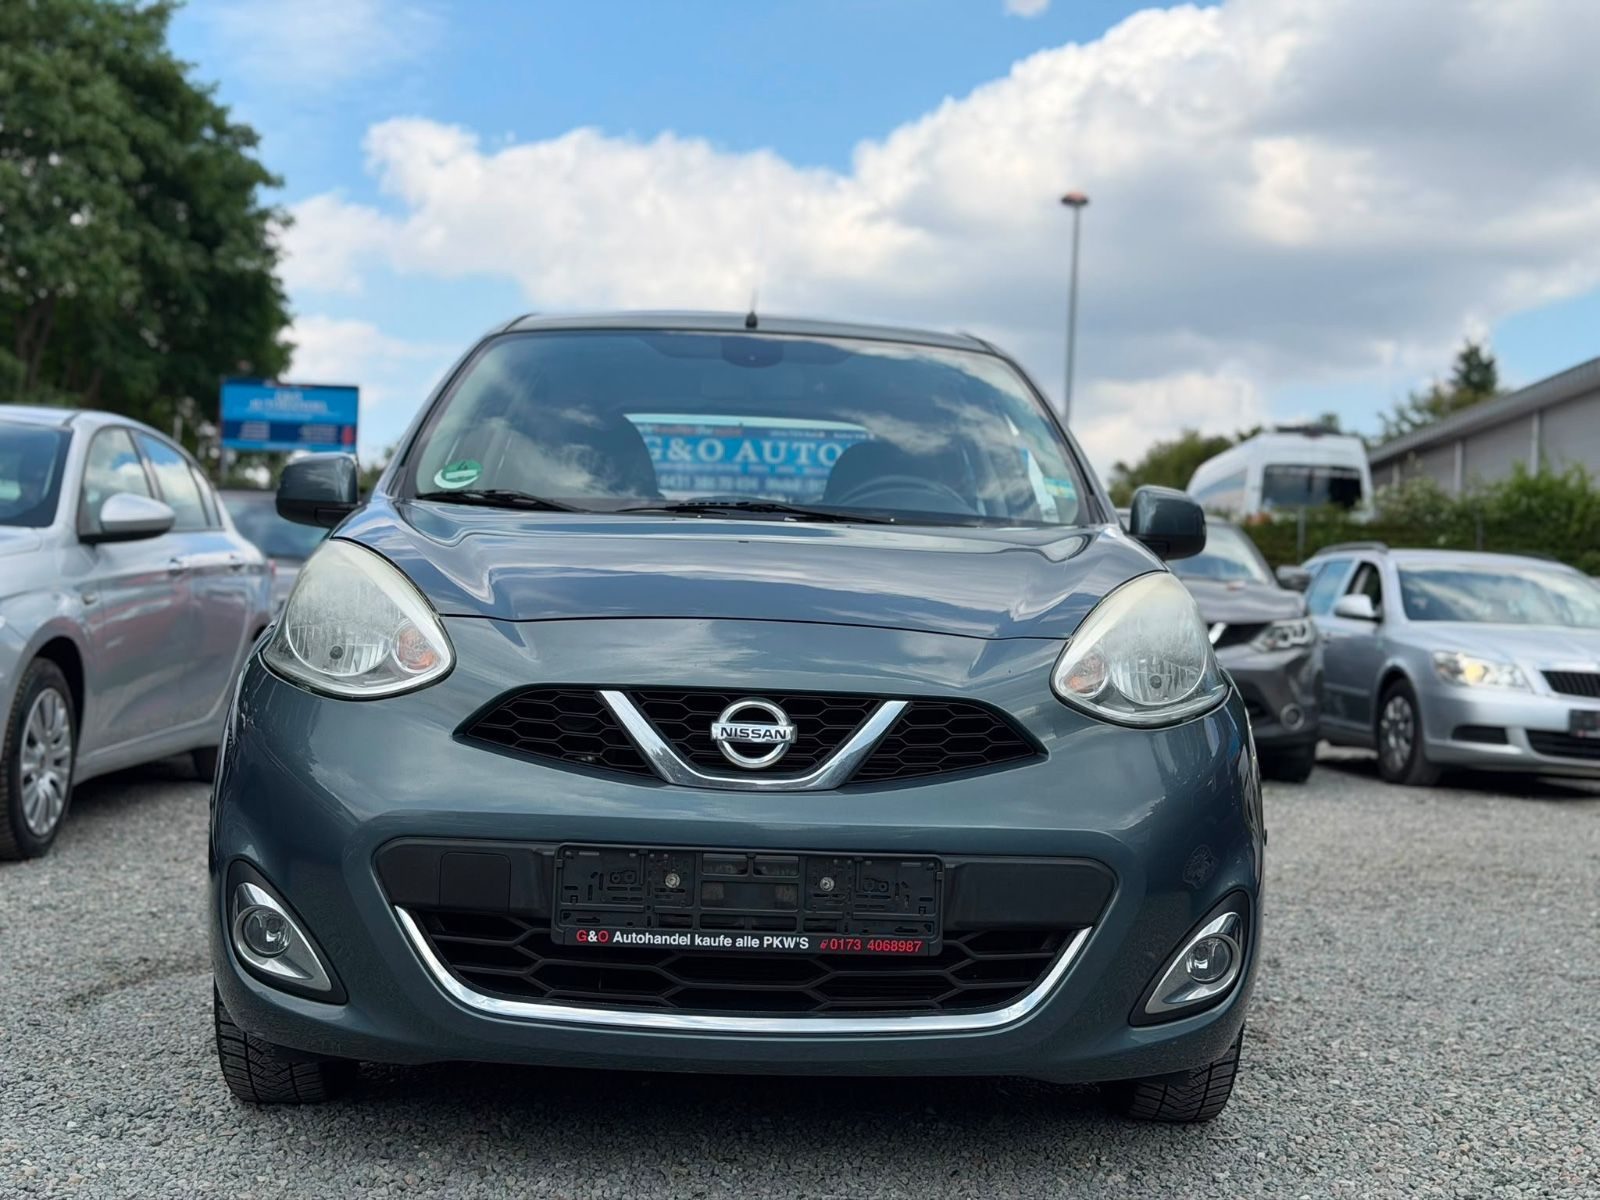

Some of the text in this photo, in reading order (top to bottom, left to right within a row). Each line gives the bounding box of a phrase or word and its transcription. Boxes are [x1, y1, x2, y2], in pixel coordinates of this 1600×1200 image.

[644, 437, 726, 463] G&O
[720, 727, 787, 740] NISSAN
[576, 929, 922, 953] G&O Autohandel kaufe alle PKW'S 0173 4068987
